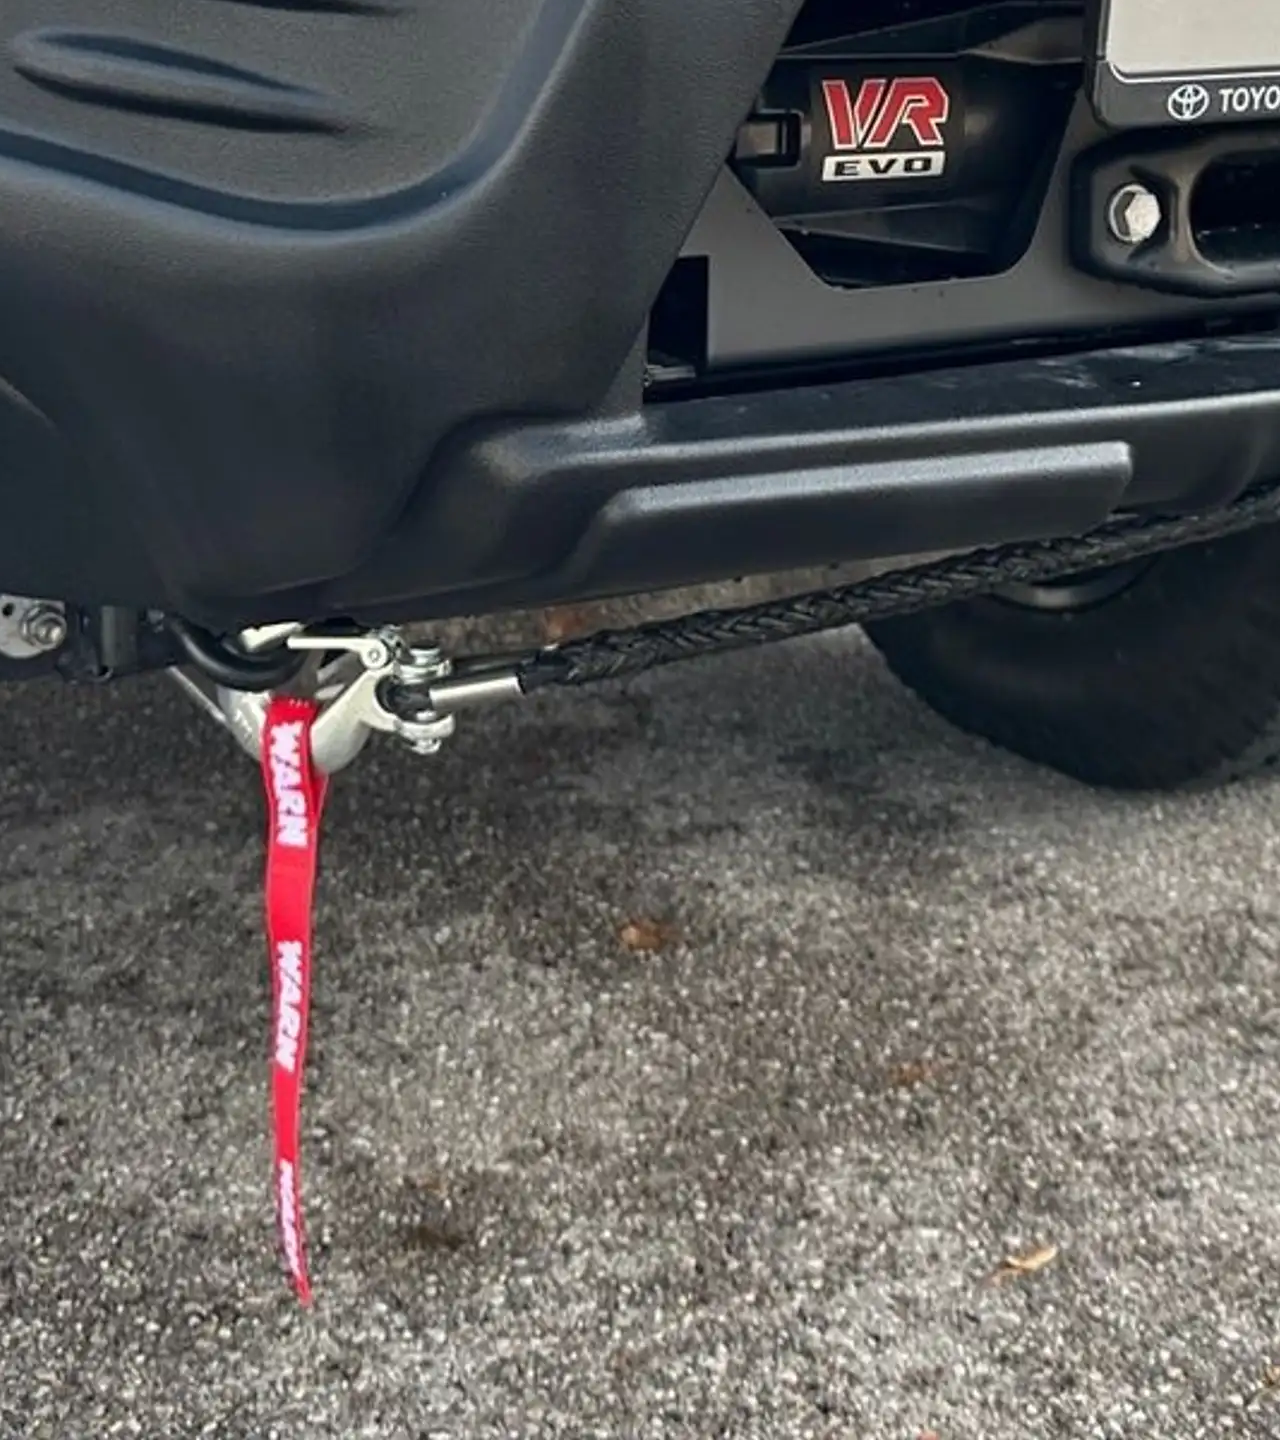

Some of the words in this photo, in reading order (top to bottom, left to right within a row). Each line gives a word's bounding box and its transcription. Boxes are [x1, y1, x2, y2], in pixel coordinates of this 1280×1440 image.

[822, 77, 950, 150] VR
[833, 157, 933, 177] EVO
[270, 720, 309, 848] WARN
[275, 939, 303, 1073] WARN
